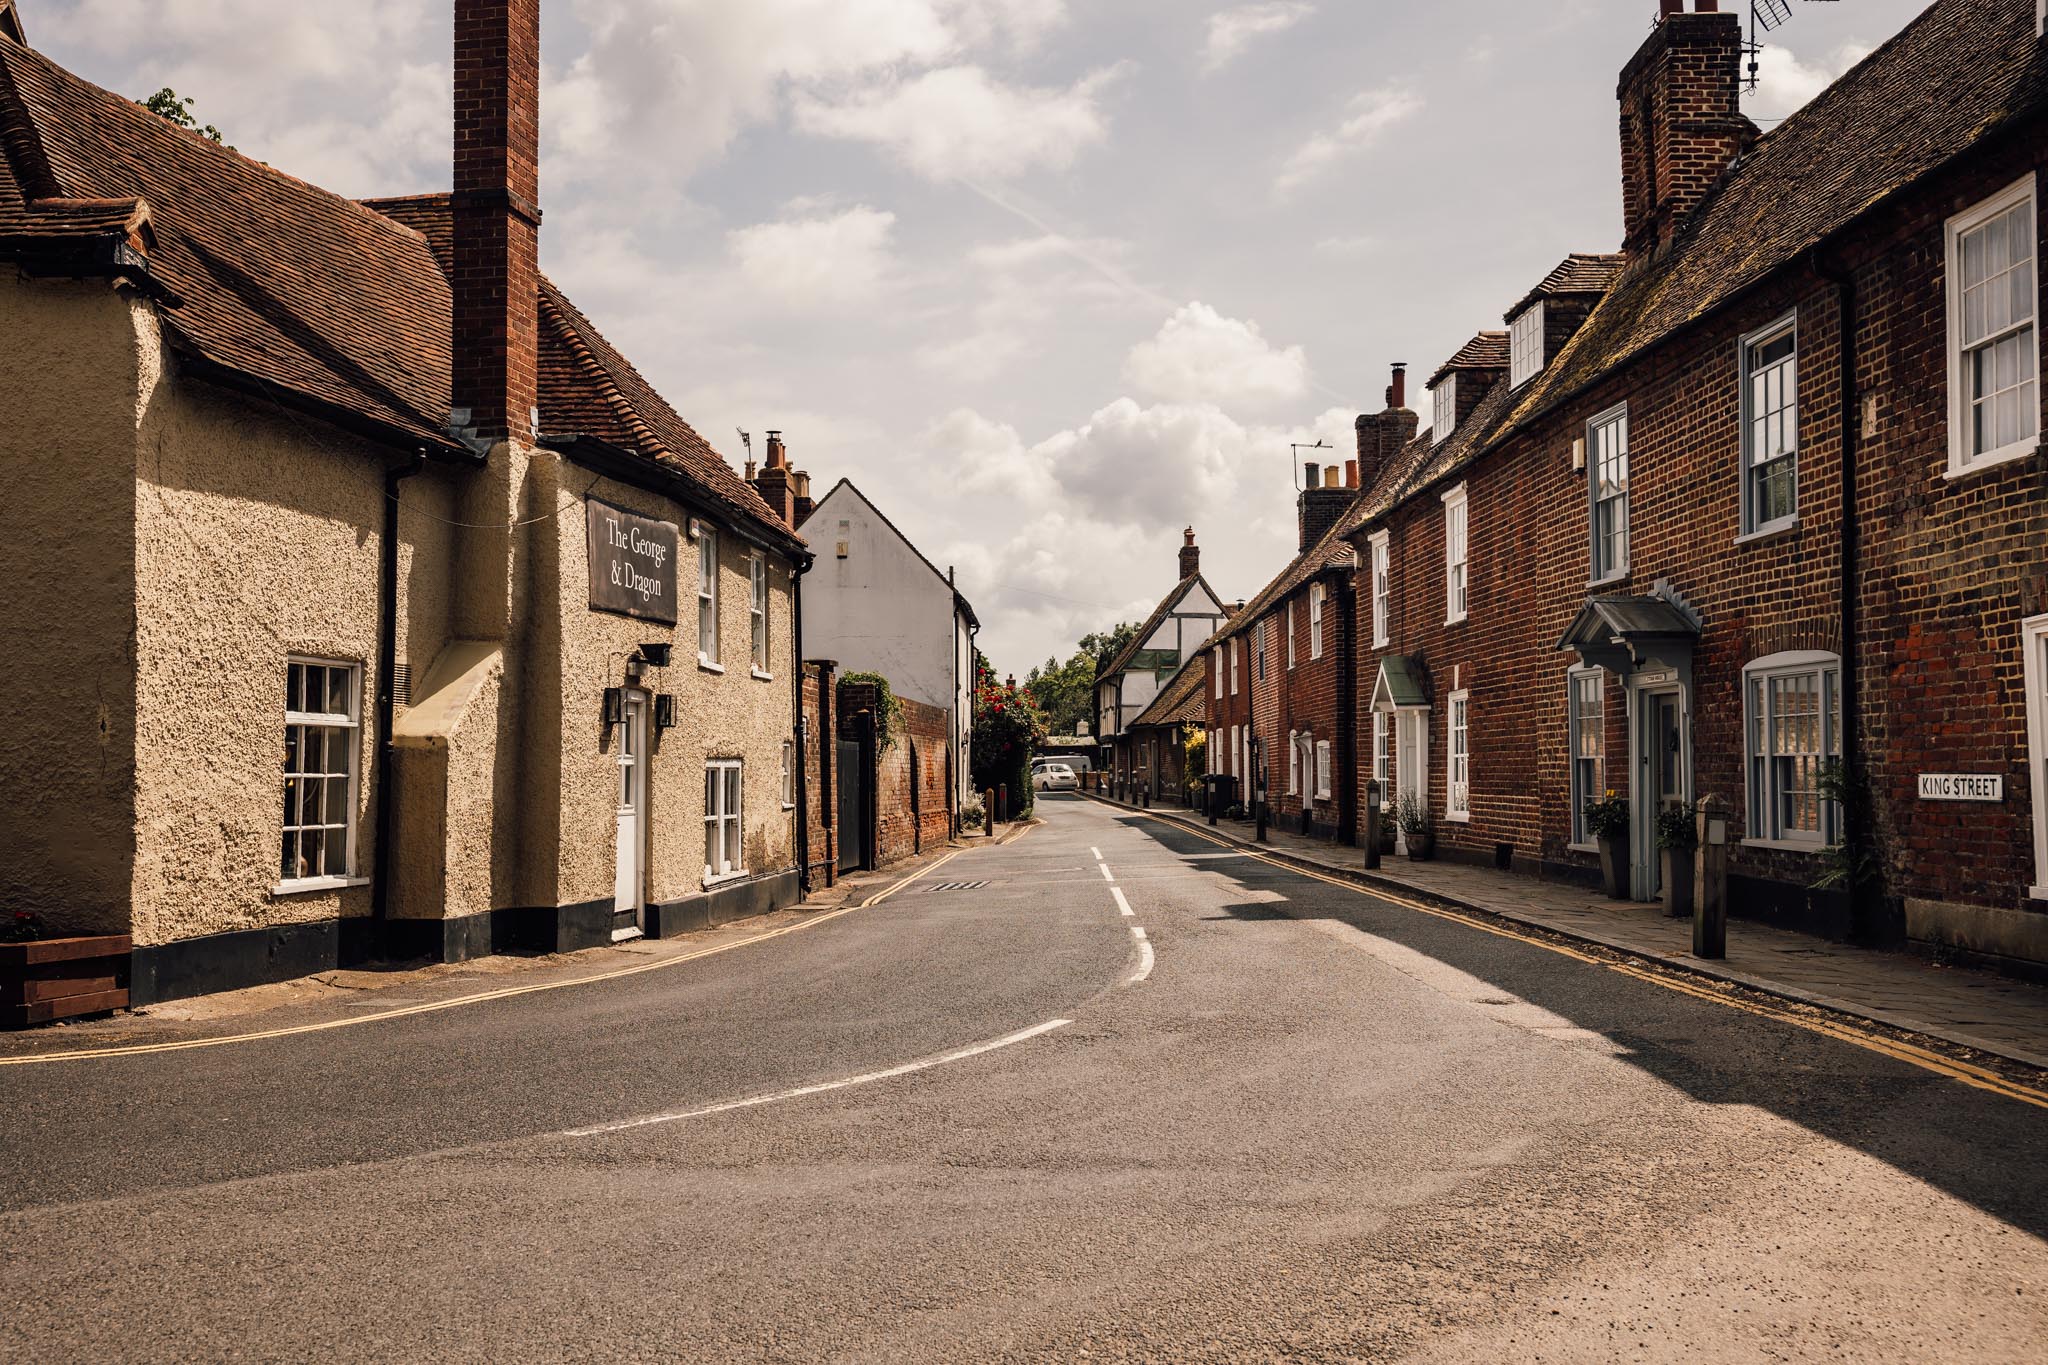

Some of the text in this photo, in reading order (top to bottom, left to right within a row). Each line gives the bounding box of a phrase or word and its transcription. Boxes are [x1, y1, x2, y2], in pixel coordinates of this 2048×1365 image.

[606, 517, 666, 568] The George
[611, 560, 661, 602] & Dragon
[1922, 777, 1997, 796] KING STREET
